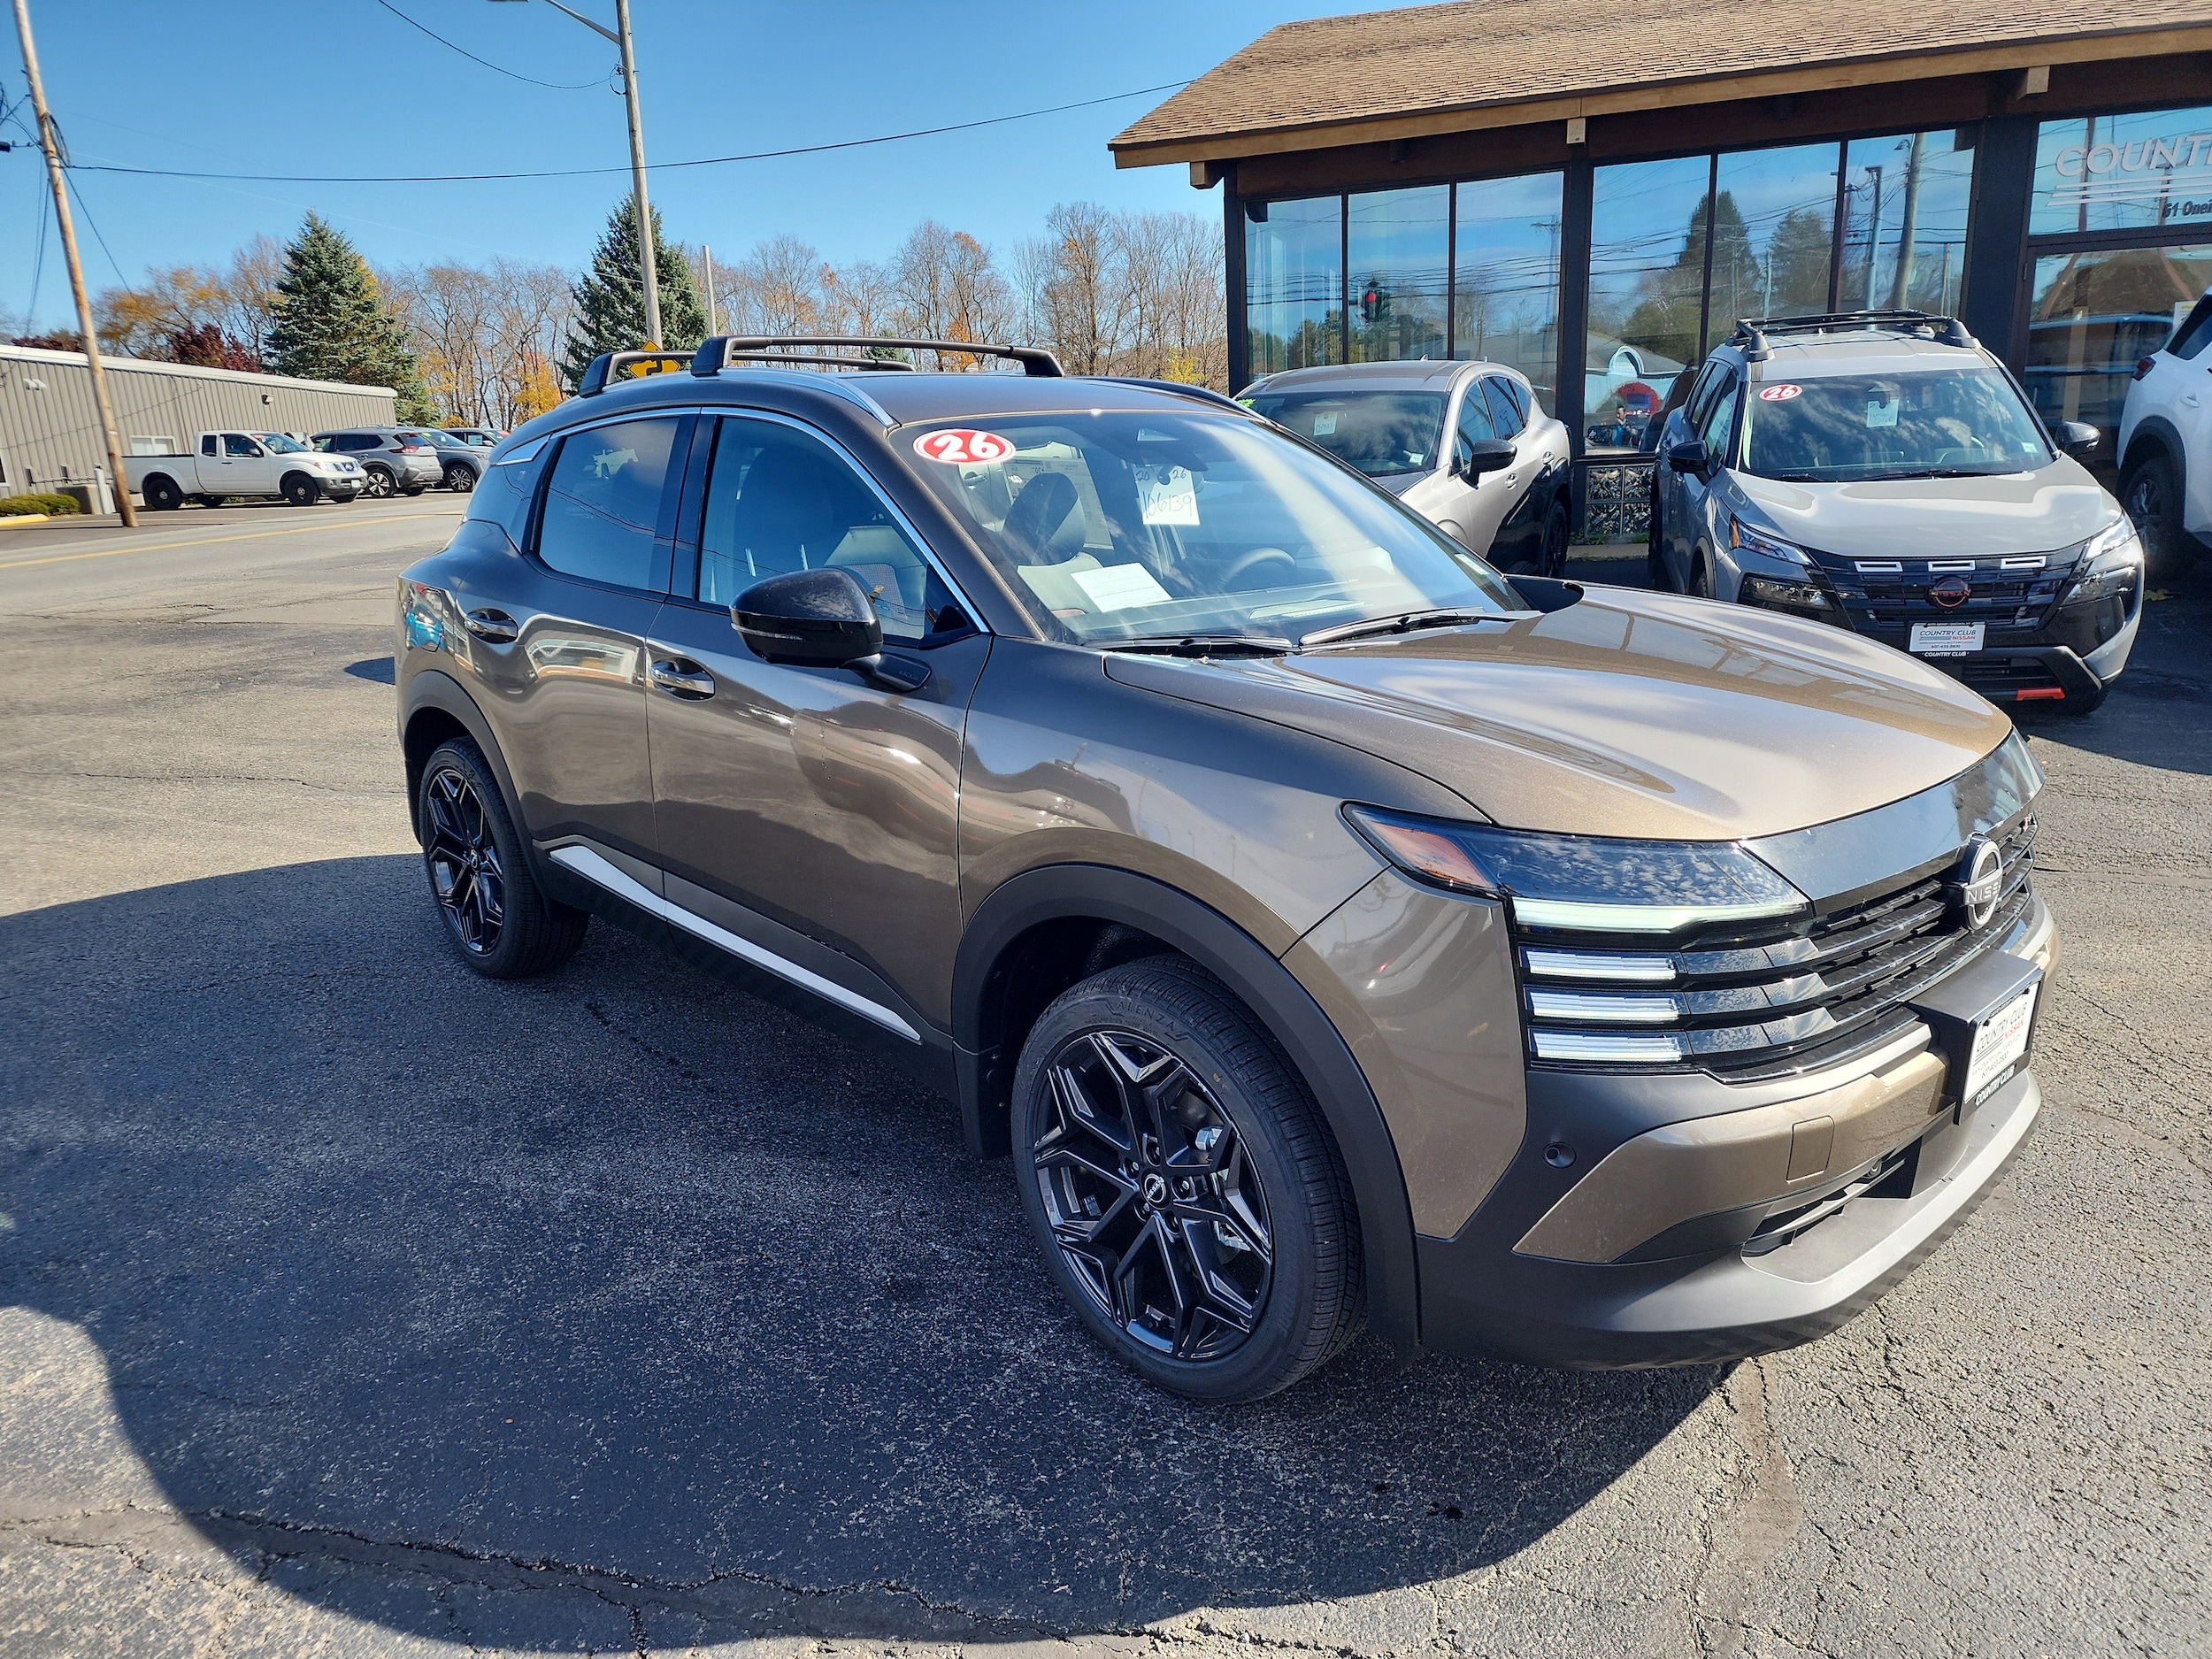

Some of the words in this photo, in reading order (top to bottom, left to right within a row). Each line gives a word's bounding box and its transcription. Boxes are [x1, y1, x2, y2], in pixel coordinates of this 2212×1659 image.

[2056, 134, 2212, 176] COUNT
[1767, 385, 1797, 398] 26
[933, 433, 1000, 460] 26
[1136, 470, 1150, 481] 20
[1172, 468, 1187, 480] 26
[1117, 1001, 1174, 1032] ALENZA
[1976, 1018, 2009, 1053] COUNTRY
[2009, 1002, 2028, 1025] CLUB
[1975, 1077, 2001, 1107] COUNTRY
[2000, 1064, 2015, 1084] CLUB
